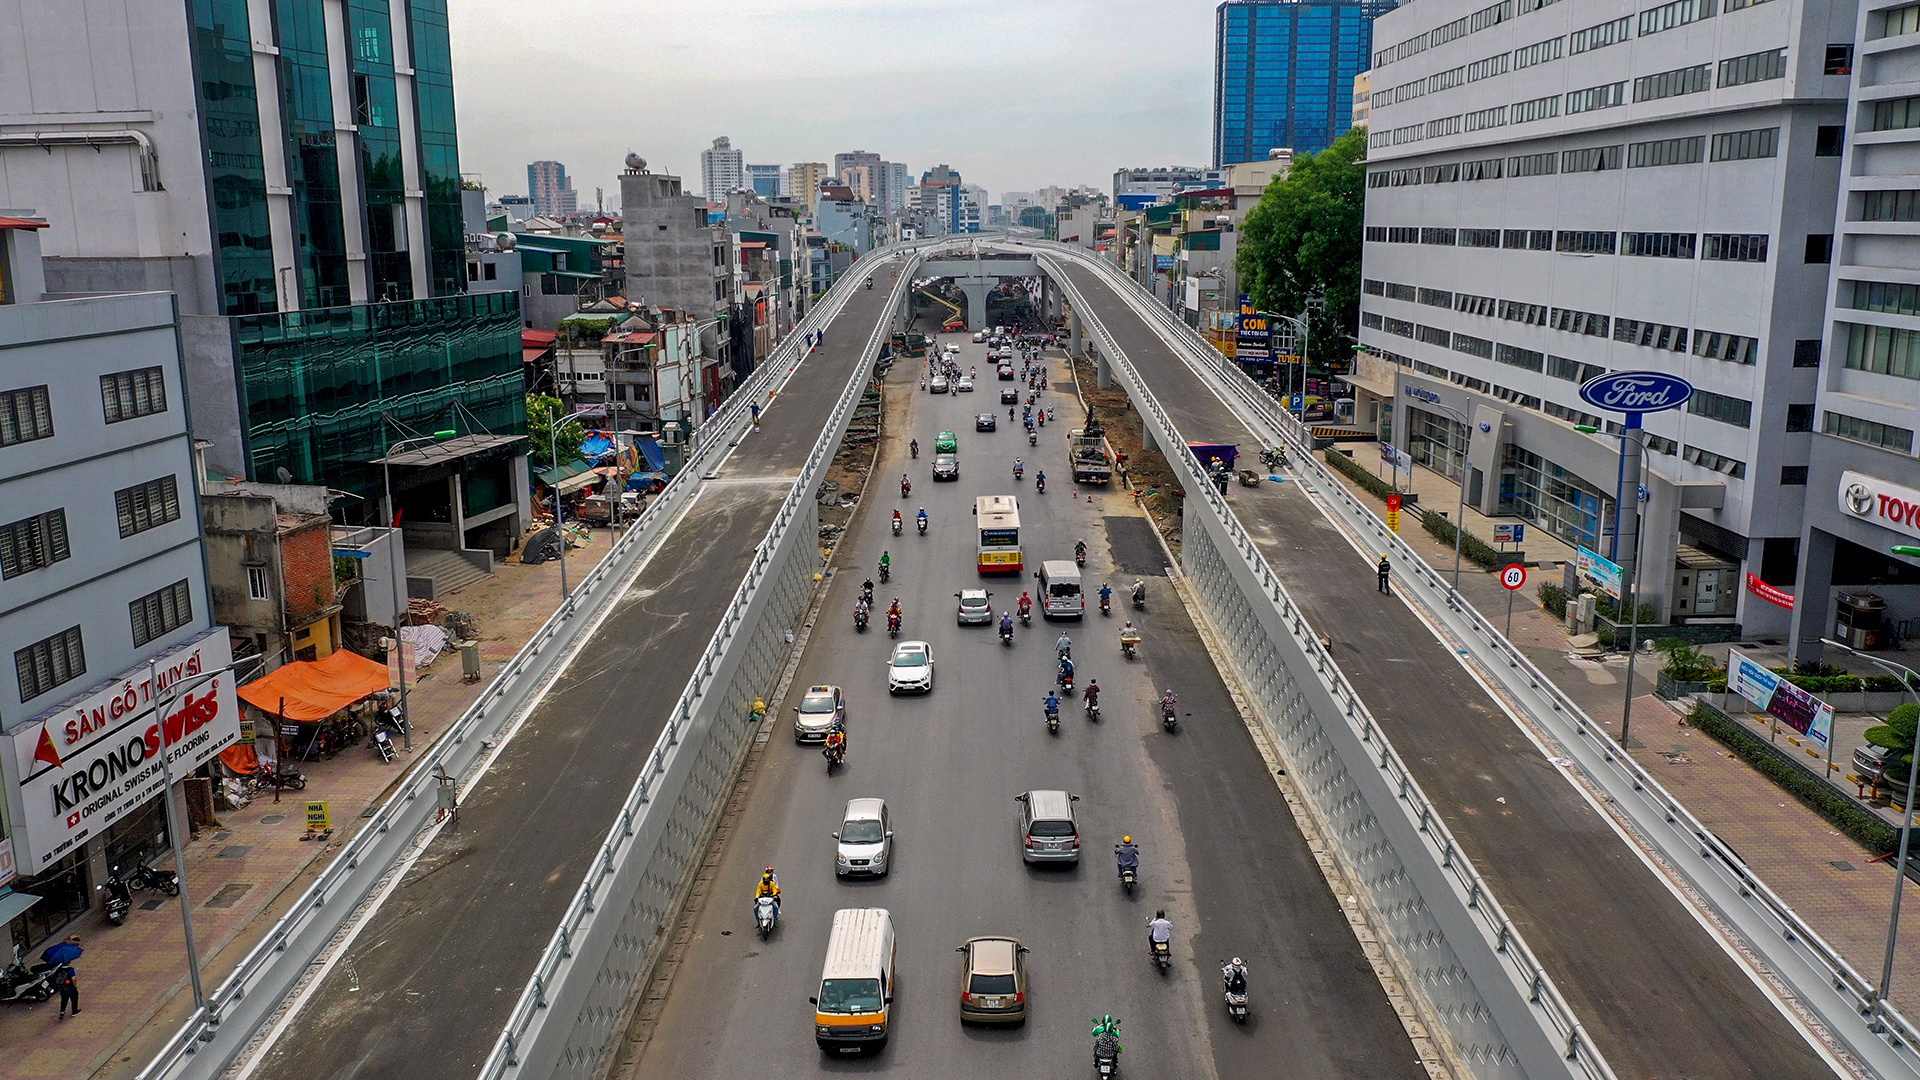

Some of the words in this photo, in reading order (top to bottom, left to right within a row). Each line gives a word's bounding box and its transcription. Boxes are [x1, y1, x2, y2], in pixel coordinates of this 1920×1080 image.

[1293, 397, 1300, 406] P
[1604, 379, 1672, 405] Ford
[1507, 571, 1519, 583] 60
[64, 705, 106, 745] SÀN
[110, 680, 138, 719] GỖ
[187, 648, 202, 677] SĨ
[82, 787, 123, 819] ORIGINAL
[124, 767, 151, 792] SWISS
[151, 752, 174, 775] MAE
[174, 731, 210, 760] FLOORING
